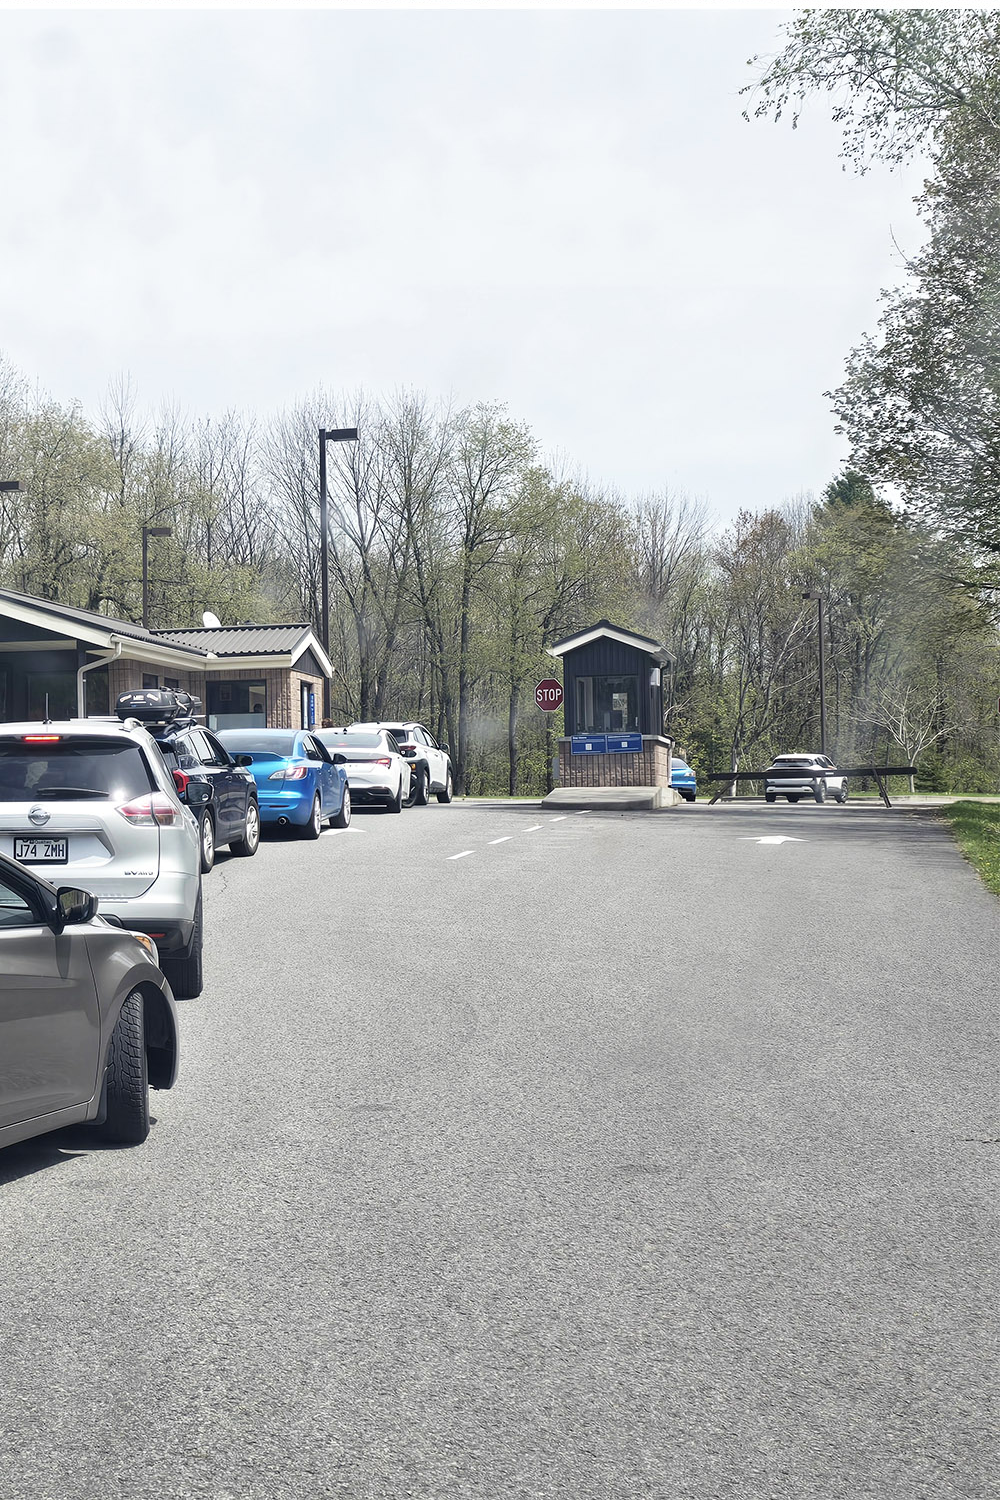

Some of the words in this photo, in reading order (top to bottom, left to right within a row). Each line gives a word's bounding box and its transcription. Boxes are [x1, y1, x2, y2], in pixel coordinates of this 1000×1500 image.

[536, 688, 562, 701] STOP
[16, 844, 37, 857] J74
[44, 844, 65, 857] ZMH
